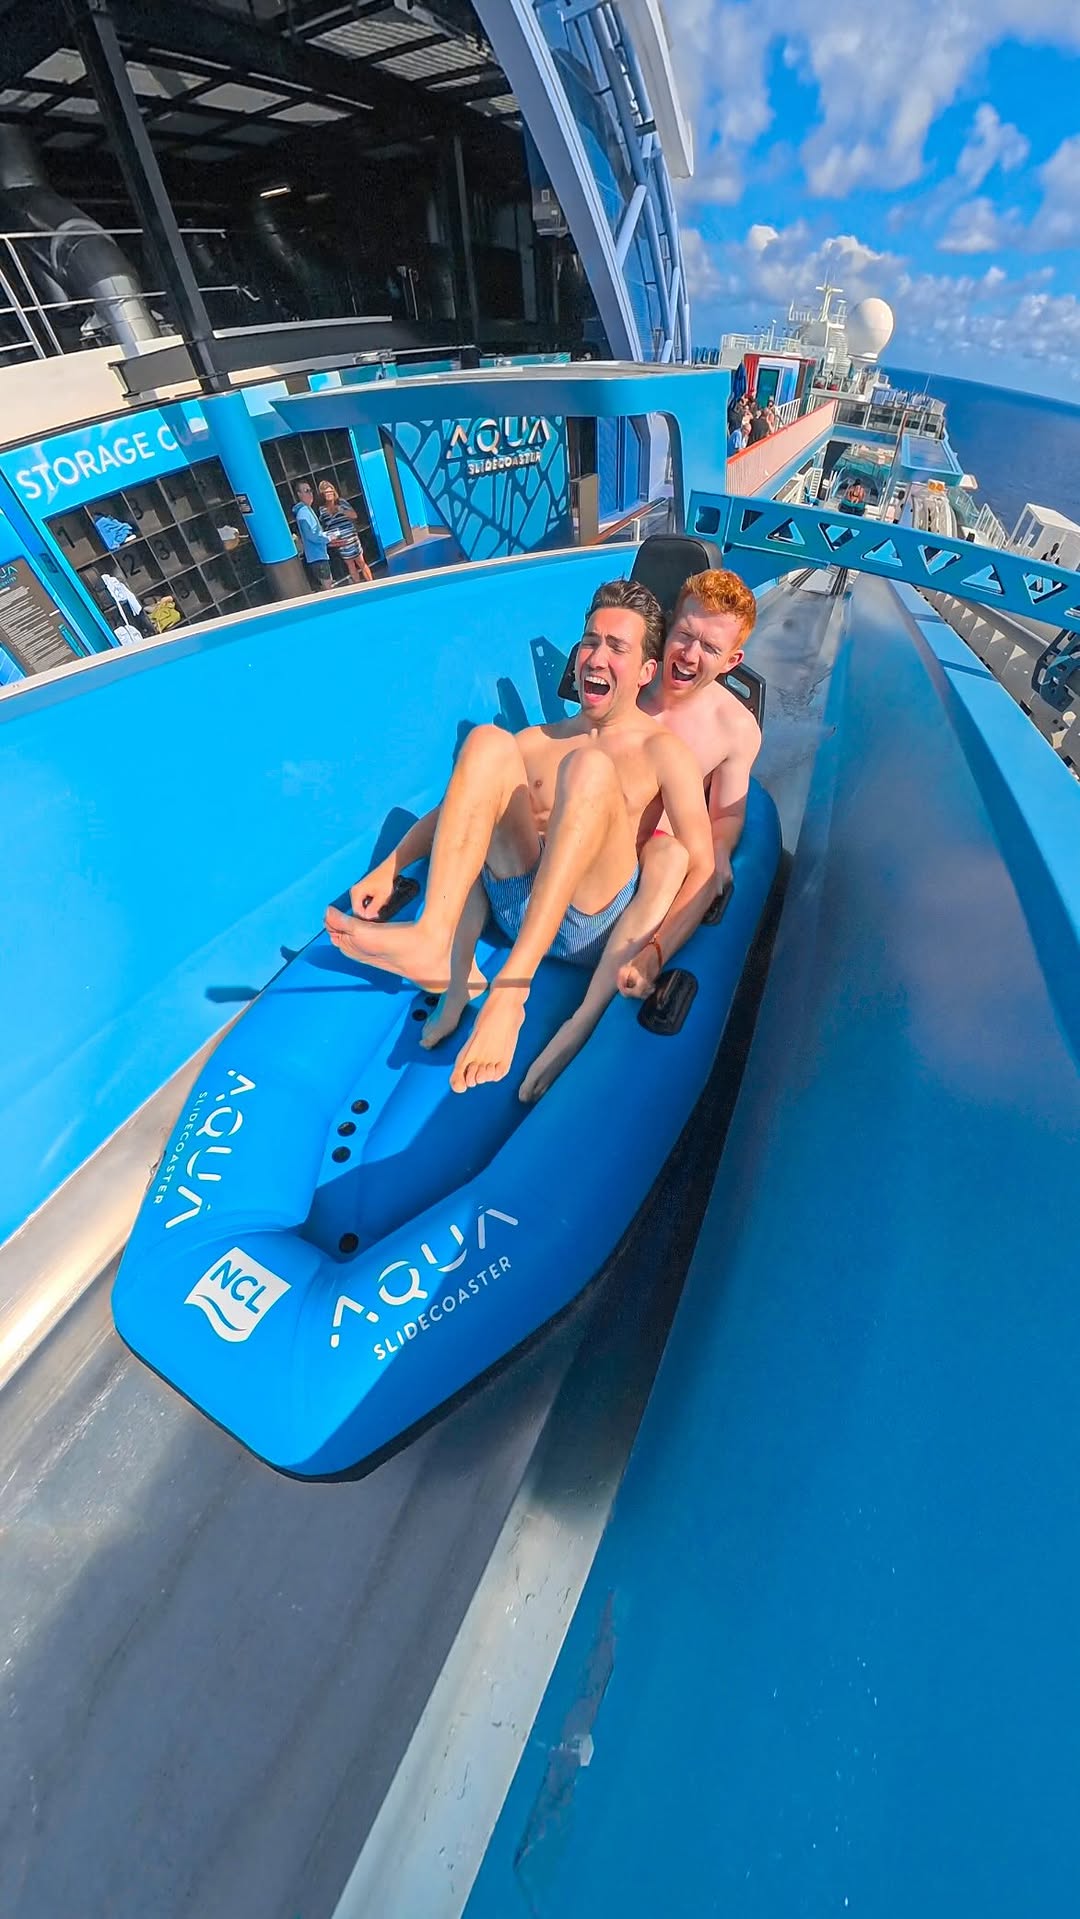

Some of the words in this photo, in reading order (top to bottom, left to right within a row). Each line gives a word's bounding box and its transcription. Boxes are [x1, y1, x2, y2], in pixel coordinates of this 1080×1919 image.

[16, 431, 156, 500] STORAGE
[446, 416, 550, 459] AQUA
[468, 451, 541, 475] SLIDECOASTER
[122, 554, 141, 577] 2
[153, 1091, 208, 1205] SLIDECOASTER
[165, 1069, 256, 1229] AQUA
[209, 1259, 269, 1315] NCL
[330, 1206, 519, 1348] AQUA
[373, 1256, 511, 1361] SLIDECOASTER
